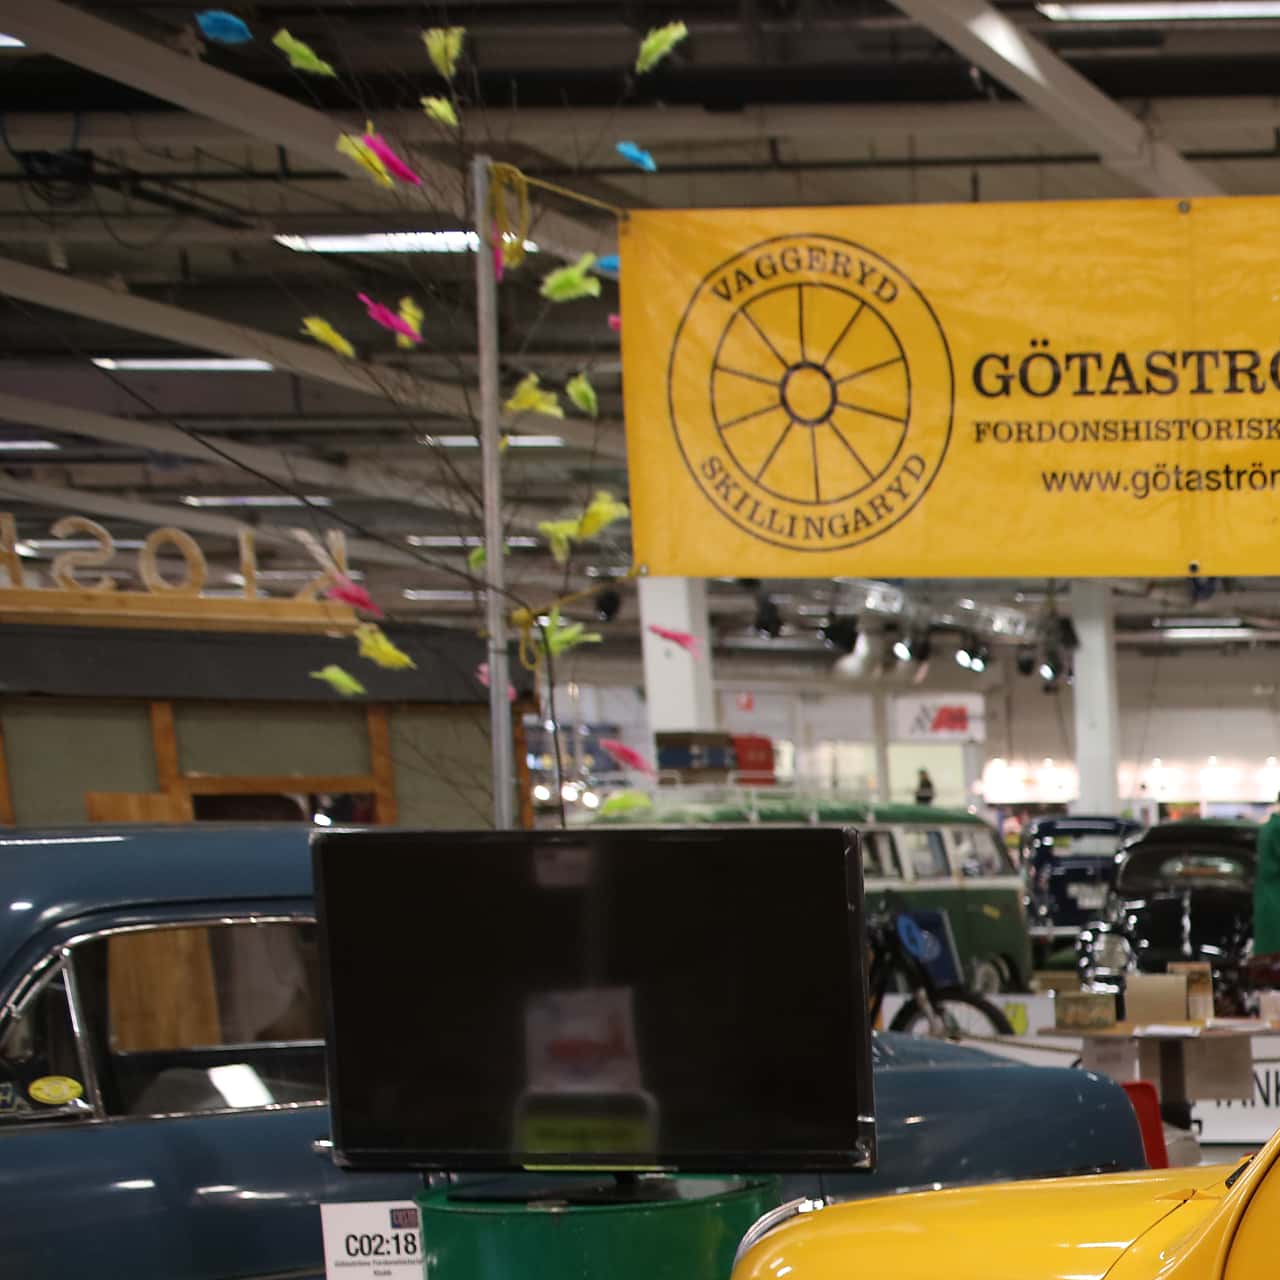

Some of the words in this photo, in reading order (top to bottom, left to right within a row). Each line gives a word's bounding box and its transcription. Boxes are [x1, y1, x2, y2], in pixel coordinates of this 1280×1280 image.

[709, 246, 899, 305] VAGGERYD
[700, 452, 927, 541] SKILLINGARYD
[345, 1232, 417, 1257] C02:18
